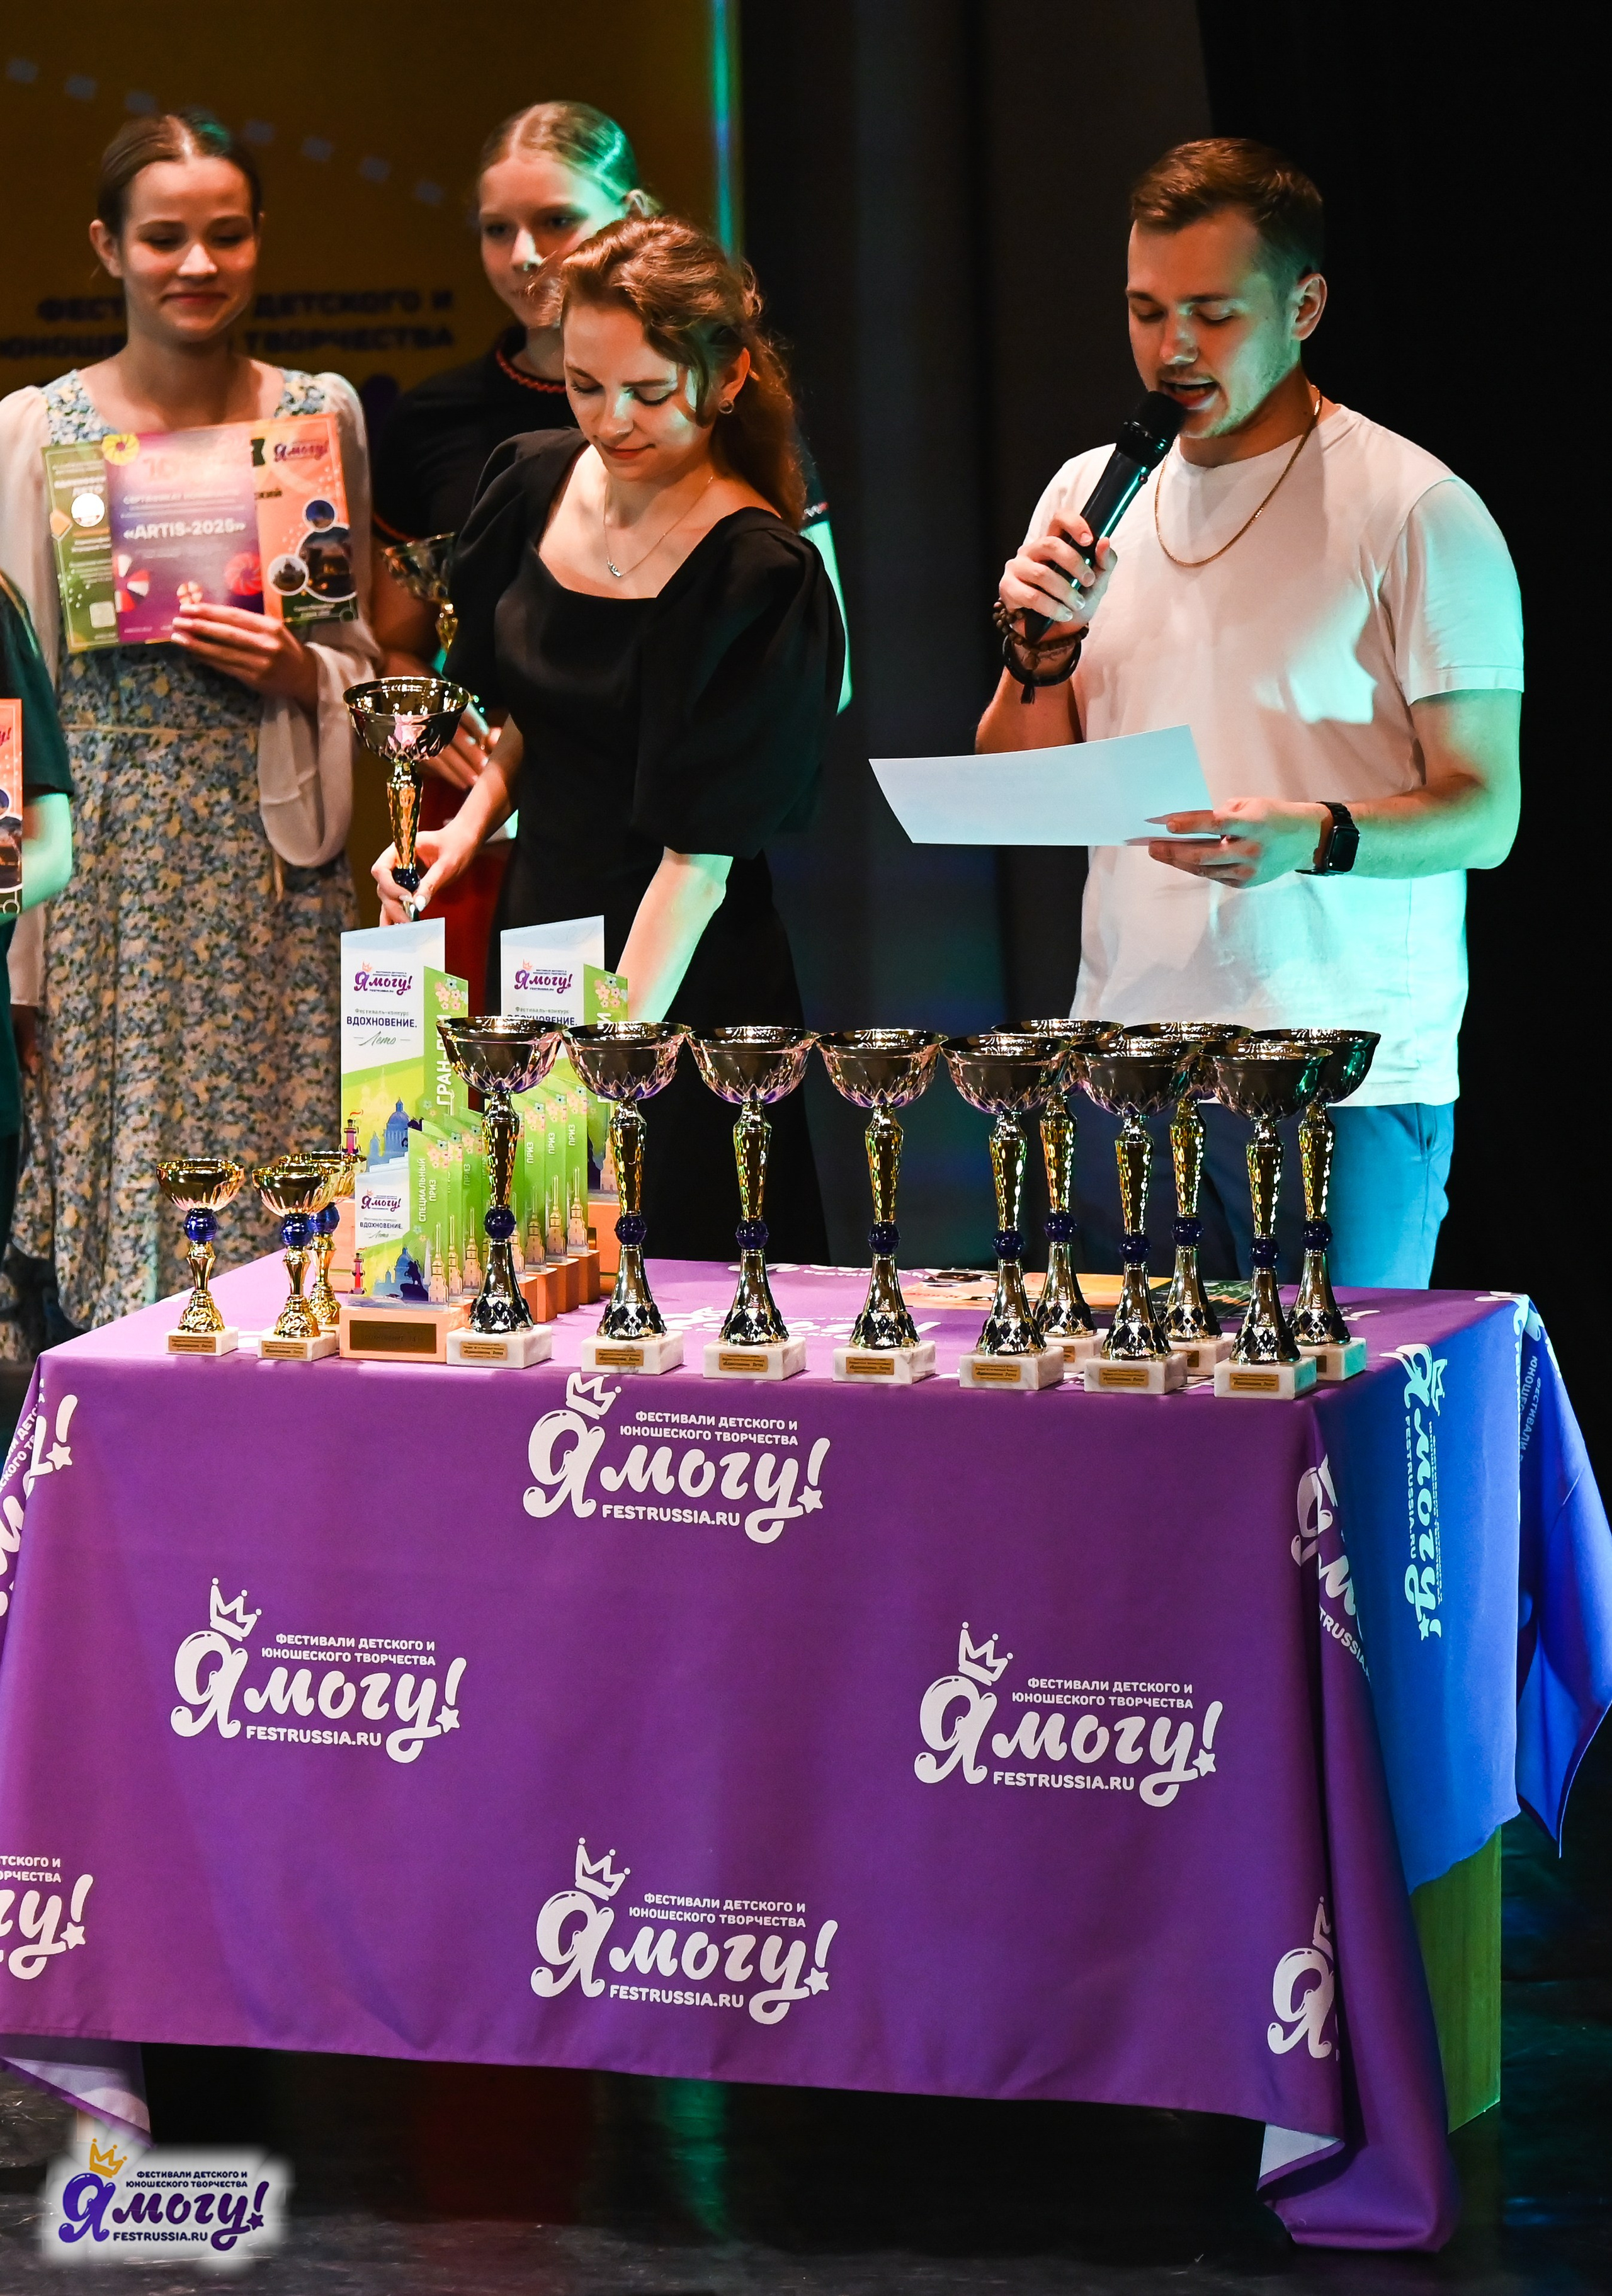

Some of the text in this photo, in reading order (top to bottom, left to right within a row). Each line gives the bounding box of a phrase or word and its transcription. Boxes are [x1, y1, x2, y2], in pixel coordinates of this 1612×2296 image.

[354, 970, 413, 996] Я могу!
[514, 969, 573, 994] Я могу!
[346, 1016, 417, 1028] ВДОХНОВЕНИЕ.
[418, 1157, 427, 1223] СПЕЦИАЛЬНЫЙ
[361, 1195, 401, 1212] Я могу!
[635, 1411, 798, 1431] ФЕСТИВАЛИ ДЕТСКОГО И
[620, 1425, 798, 1446] ЮНОШЕСКОГО ТВОРЧЕСТВА
[523, 1409, 831, 1544] Я могу!
[1404, 1415, 1417, 1560] FESTRUSSIA.RU
[602, 1504, 740, 1526] FESTRUSSIA.RU
[276, 1633, 435, 1651] ФЕСТИВАЛИ ДЕТСКОГО И
[261, 1647, 436, 1666] ЮНОШЕСКОГО ТВОРЧЕСТВА
[1028, 1677, 1193, 1694] ФЕСТИВАЛИ ДЕТСКОГО И
[170, 1630, 467, 1763] Я могу!
[1012, 1692, 1193, 1709] ЮНОШЕСКОГО ТВОРЧЕСТВА
[246, 1725, 382, 1746] FESTRUSSIA.RU
[914, 1675, 1223, 1807] Я могу!
[993, 1771, 1135, 1790] FESTRUSSIA.RU
[0, 1855, 61, 1868] ТСКОГО И
[644, 1892, 805, 1913] ФЕСТИВАЛИ ДЕТСКОГО И
[629, 1906, 806, 1928] ЮНОШЕСКОГО ТВОРЧЕСТВА
[530, 1890, 838, 2025] Я могу!
[610, 1984, 744, 2008] FESTRUSSIA.RU
